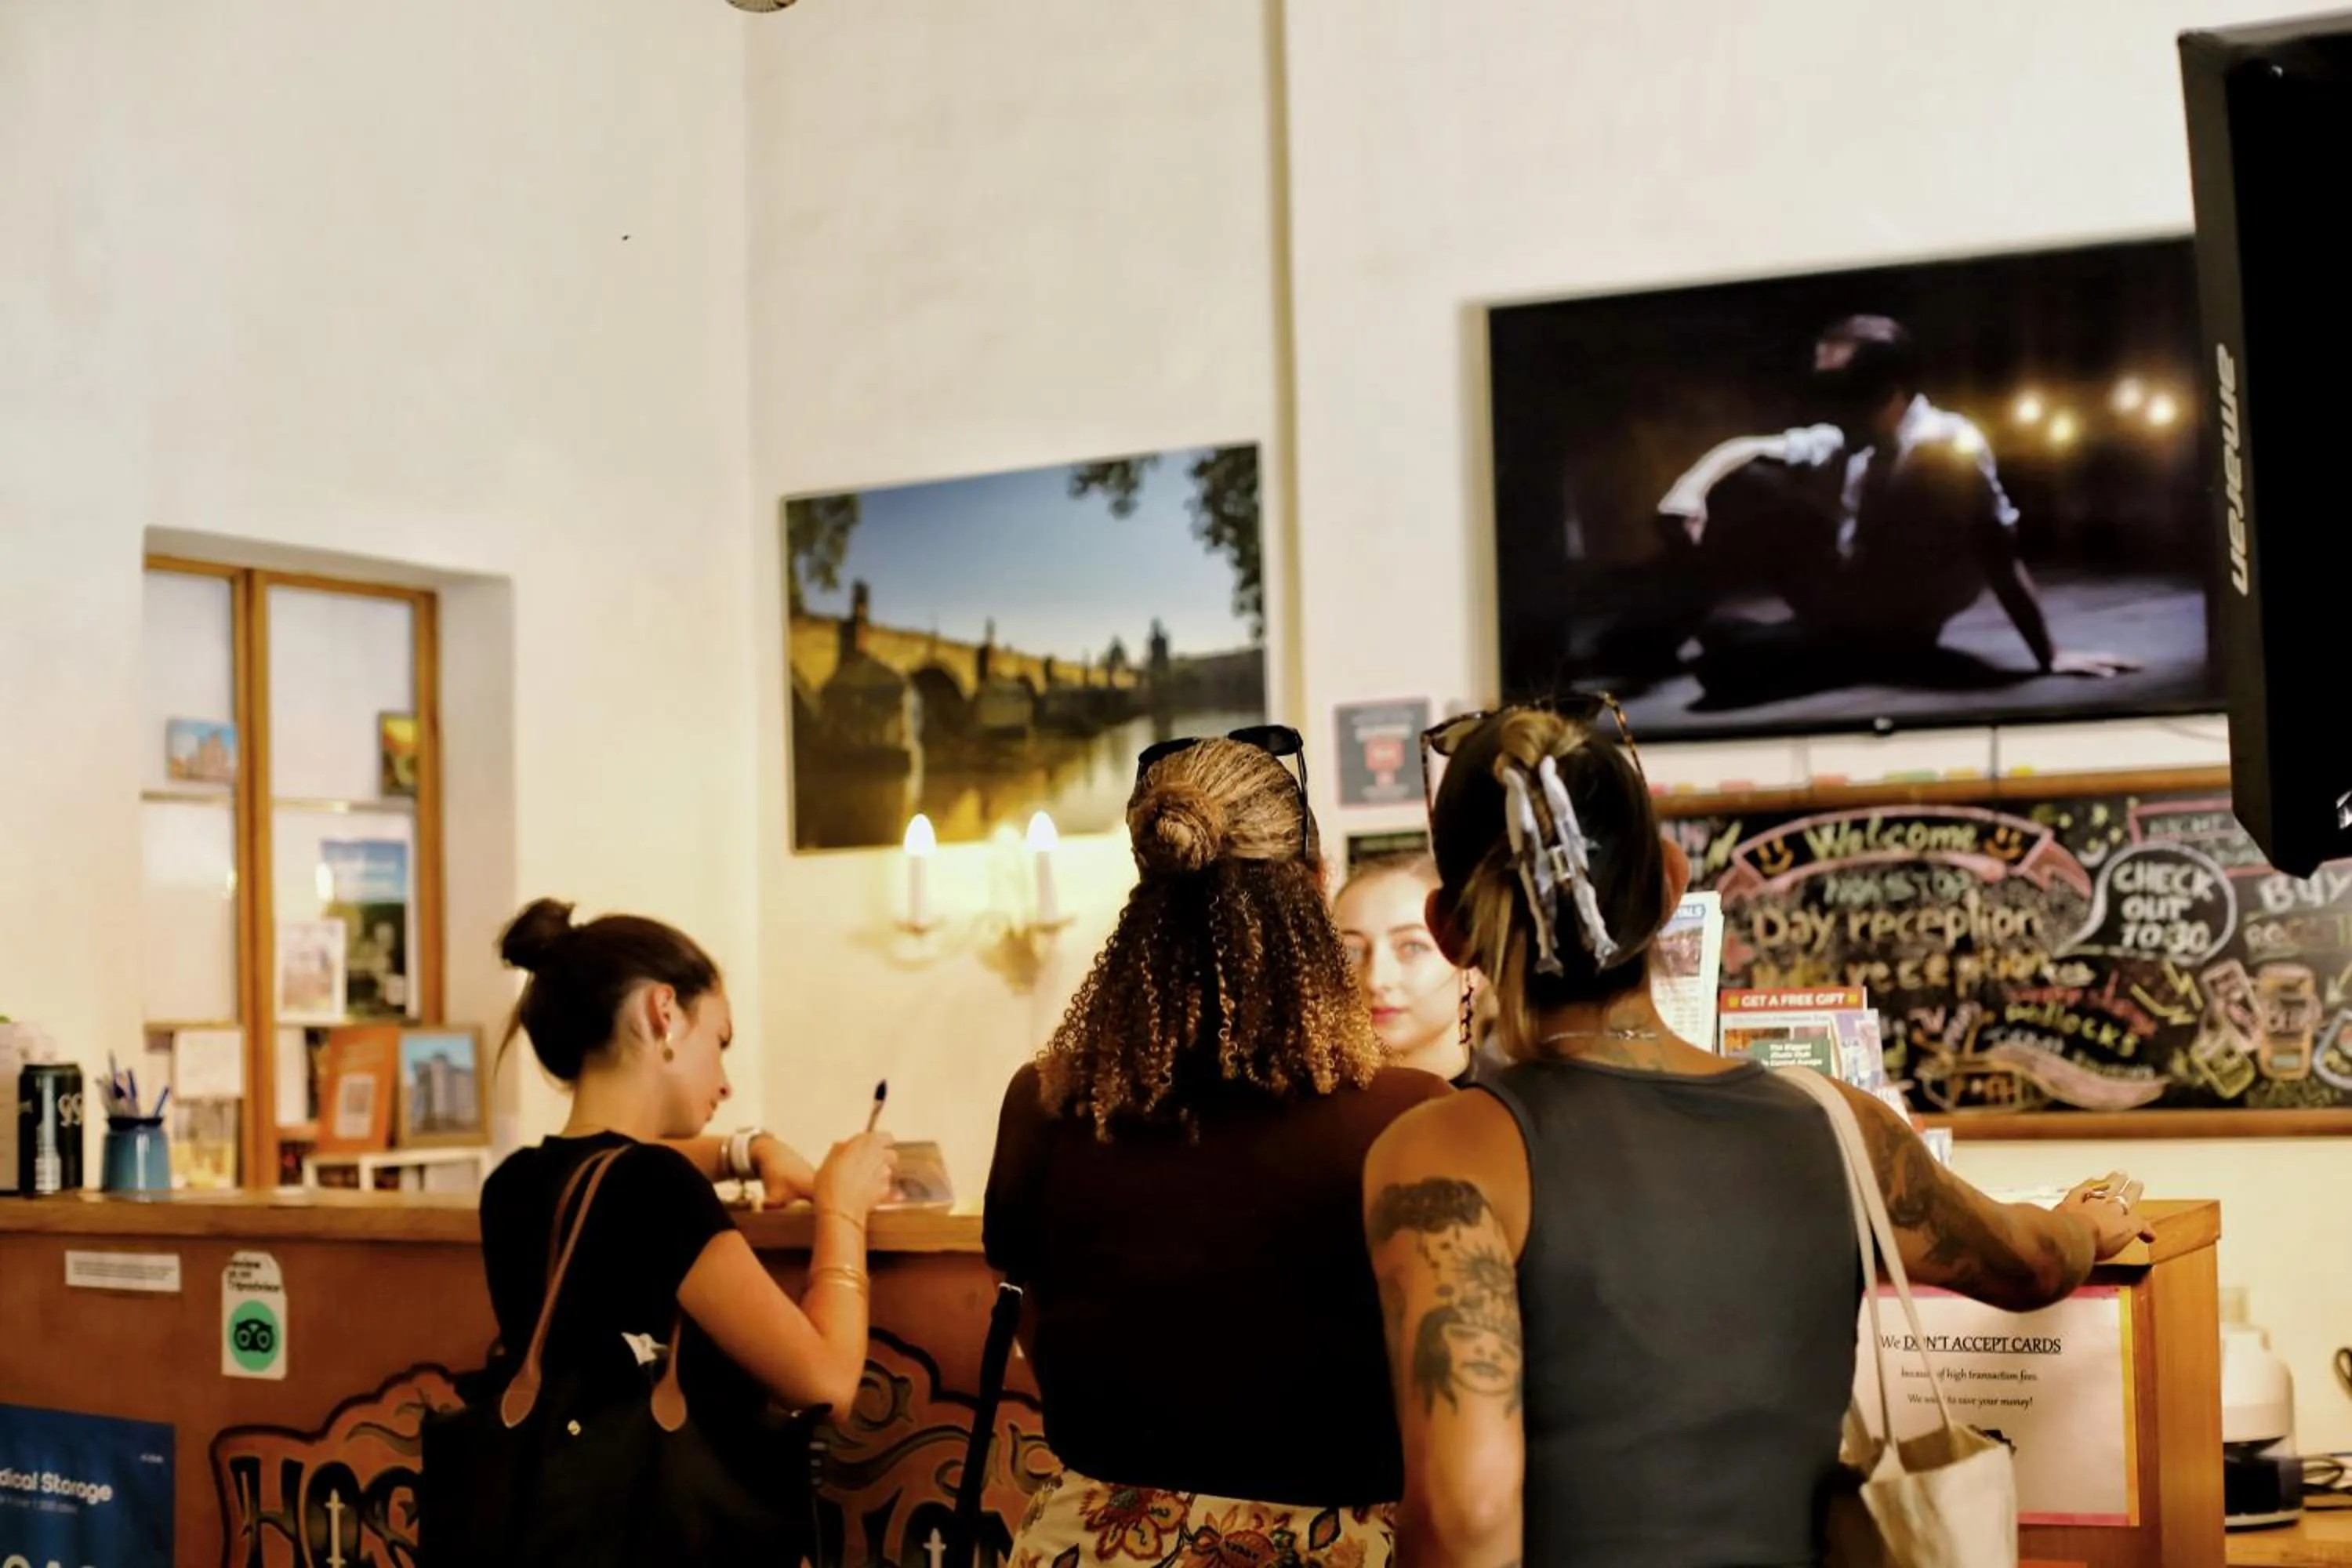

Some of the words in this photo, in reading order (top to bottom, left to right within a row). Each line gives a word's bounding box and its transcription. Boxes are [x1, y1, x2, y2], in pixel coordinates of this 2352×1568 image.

[2216, 343, 2248, 597] amaran
[1804, 812, 1978, 859] Welcome
[2112, 861, 2216, 902] CHECK
[1753, 905, 1835, 954] Day
[1846, 887, 2042, 949] reception
[2120, 895, 2193, 921] OUT
[1741, 994, 1767, 1007] GET
[1768, 994, 1779, 1007] A
[1780, 993, 1814, 1006] FREE
[1815, 992, 1845, 1005] GIFT
[1881, 1335, 1900, 1349] We
[1951, 1336, 2009, 1351] ACCEPT
[2011, 1338, 2062, 1353] CARDS
[1901, 1366, 1931, 1377] becaus
[1947, 1367, 1967, 1382] high
[1969, 1370, 2019, 1380] transaction
[1907, 1392, 1922, 1404] We
[1947, 1396, 1957, 1404] to
[1977, 1398, 1998, 1410] your
[2000, 1396, 2034, 1411] money!
[42, 1470, 114, 1505] Storage
